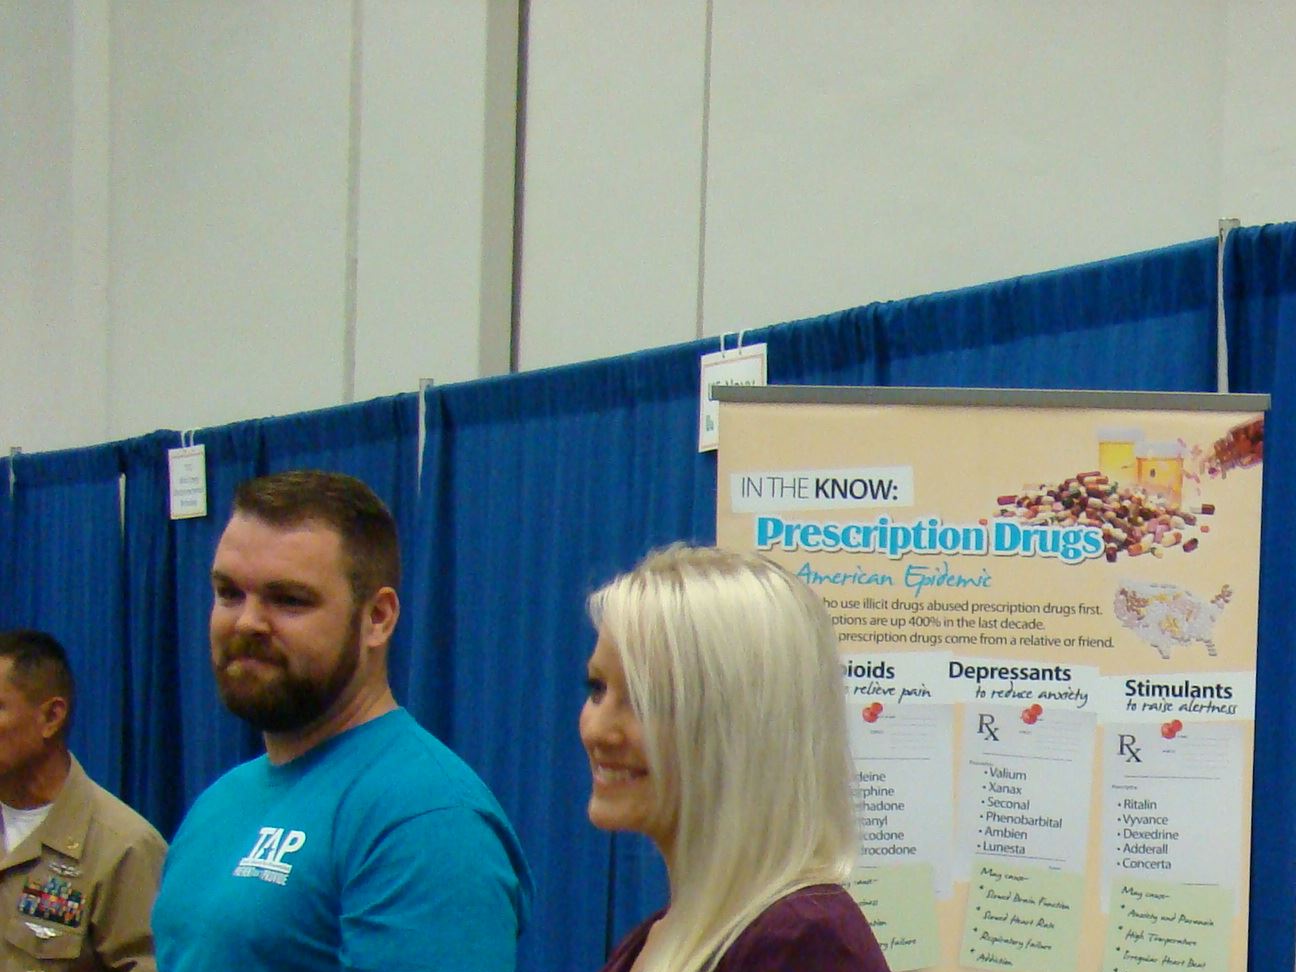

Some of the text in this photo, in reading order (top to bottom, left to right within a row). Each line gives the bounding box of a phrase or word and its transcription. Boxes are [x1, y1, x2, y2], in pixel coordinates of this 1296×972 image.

[741, 477, 898, 499] IN THE KNOW:
[756, 516, 1102, 561] Prescription Drugs
[797, 562, 992, 596] American Epidemic
[841, 599, 1103, 616] use illicit drugs abused prescription drugs first.
[949, 662, 1071, 683] Depressants
[853, 682, 931, 703] relieve pain
[1125, 679, 1233, 699] Stimulants
[989, 768, 1027, 781] Valium
[989, 783, 1022, 795] Xanax
[987, 797, 1030, 810] Seconal
[1124, 798, 1157, 810] Ritalin
[985, 812, 1062, 828] Phenobarbital
[1123, 814, 1169, 826] Vyvance
[984, 827, 1028, 840] Ambien
[1123, 829, 1179, 840] Dexedrine
[247, 827, 306, 863] TAP
[983, 842, 1026, 855] Lunesta
[1123, 843, 1168, 855] Adderall
[1122, 858, 1171, 870] Concerta
